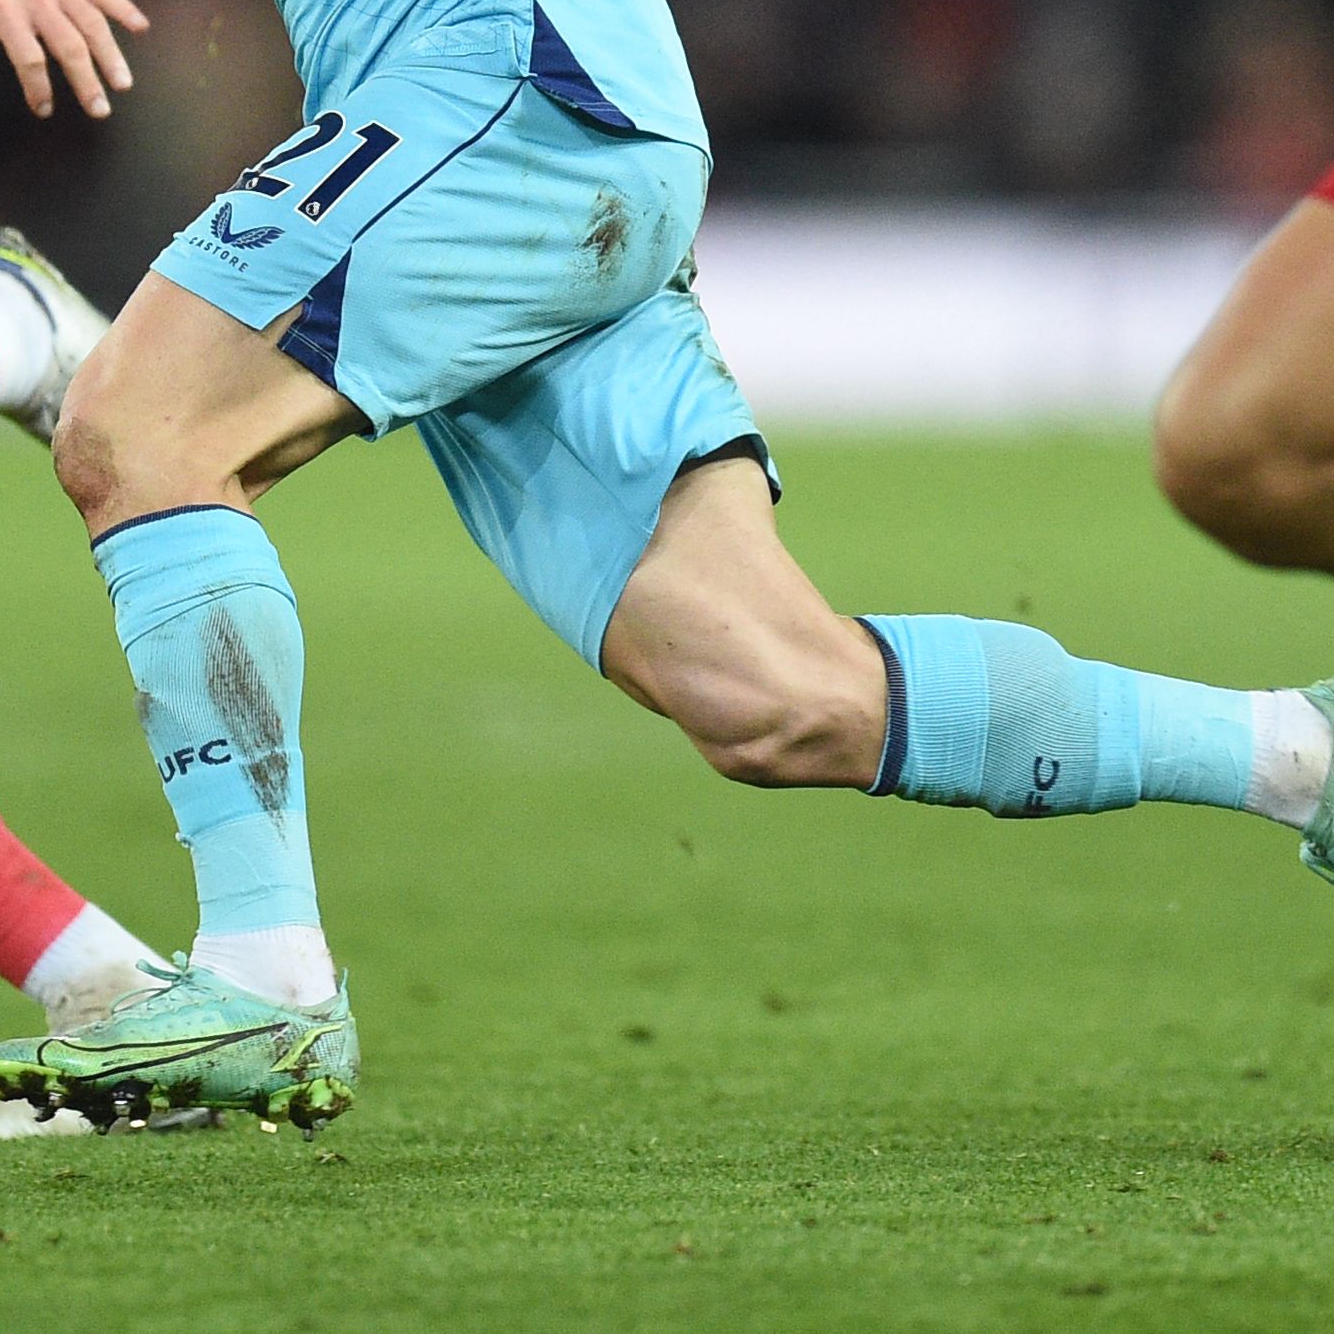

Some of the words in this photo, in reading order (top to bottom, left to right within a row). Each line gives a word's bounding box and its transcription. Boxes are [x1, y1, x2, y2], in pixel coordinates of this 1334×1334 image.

[224, 110, 404, 226] 21
[188, 236, 249, 273] CASTORE
[158, 738, 232, 783] UFC
